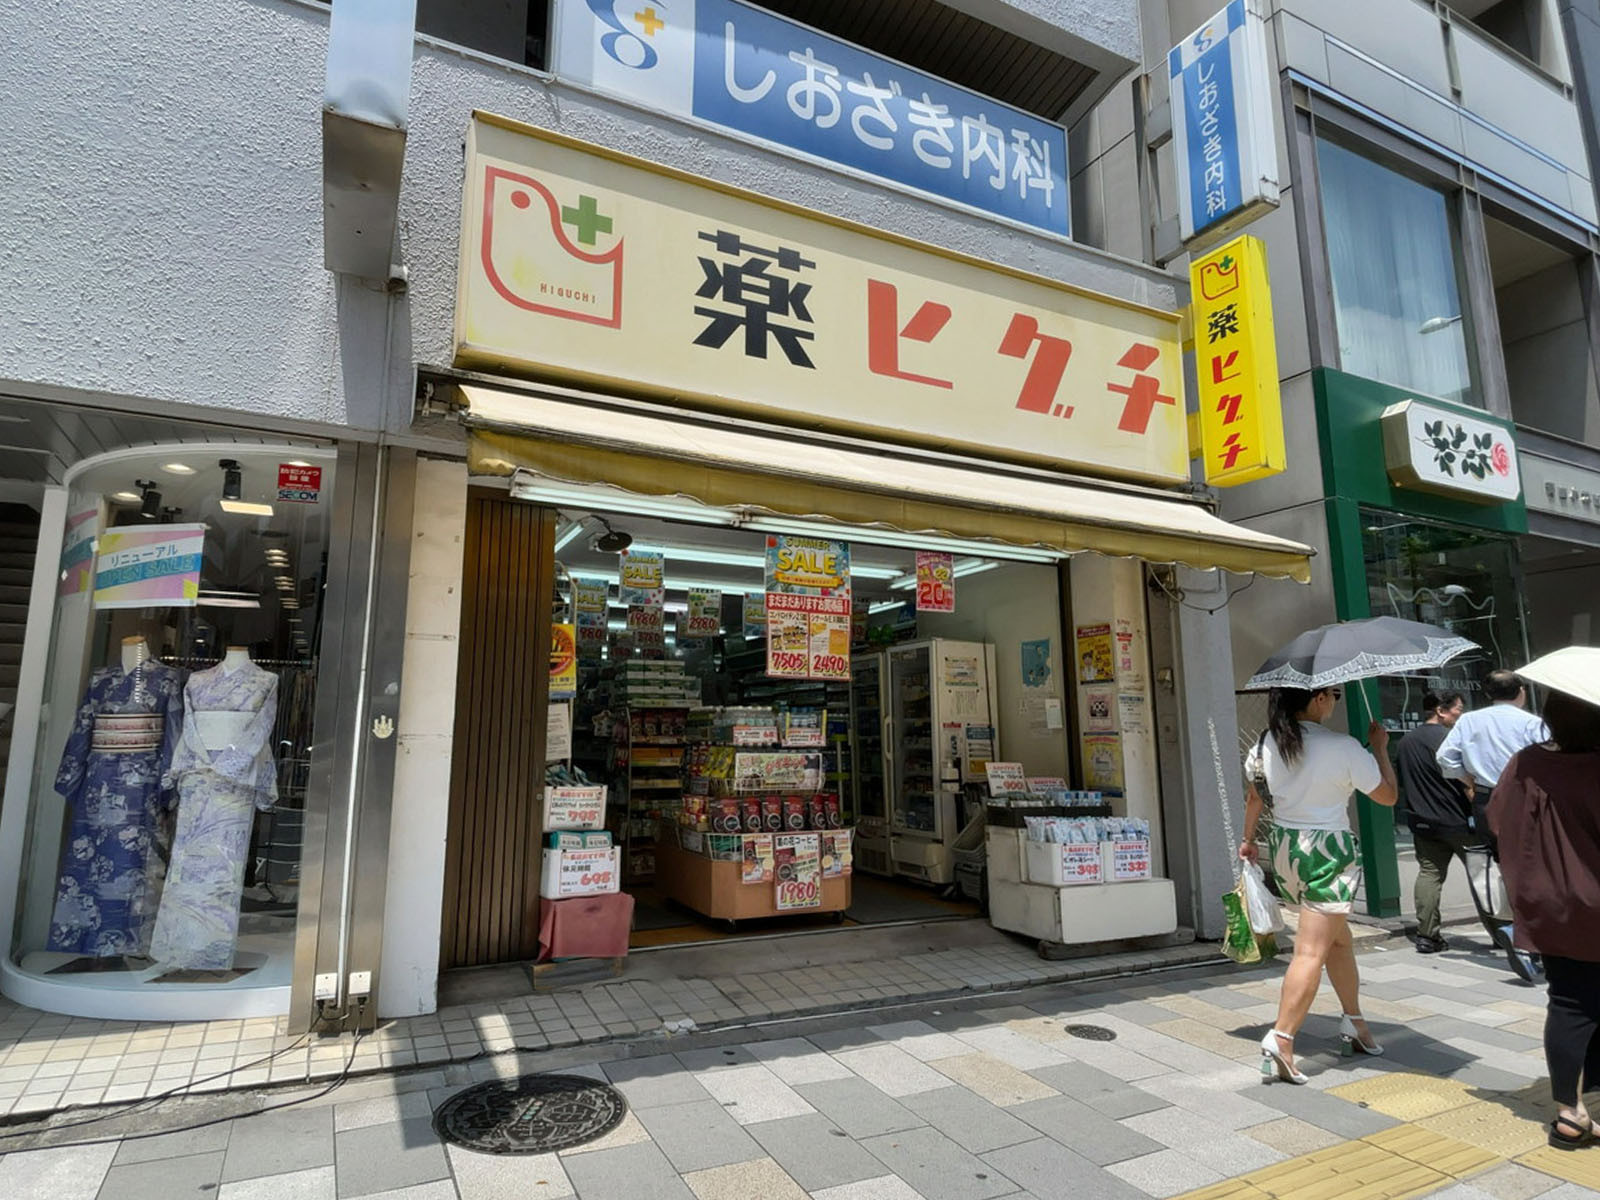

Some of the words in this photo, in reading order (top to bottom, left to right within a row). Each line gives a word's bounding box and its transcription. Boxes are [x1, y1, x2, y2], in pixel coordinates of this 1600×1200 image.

[724, 21, 1054, 208] しおざき内科
[1198, 62, 1227, 218] しおざき内科
[540, 282, 596, 304] HIGUCHI
[278, 490, 317, 500] SECOM
[786, 536, 831, 551] SUMMER
[112, 544, 178, 566] リニューアル
[777, 549, 837, 575] SALE
[146, 556, 194, 578] SALE
[624, 565, 662, 579] SALE
[813, 654, 844, 671] 2490
[780, 881, 816, 901] 1980
